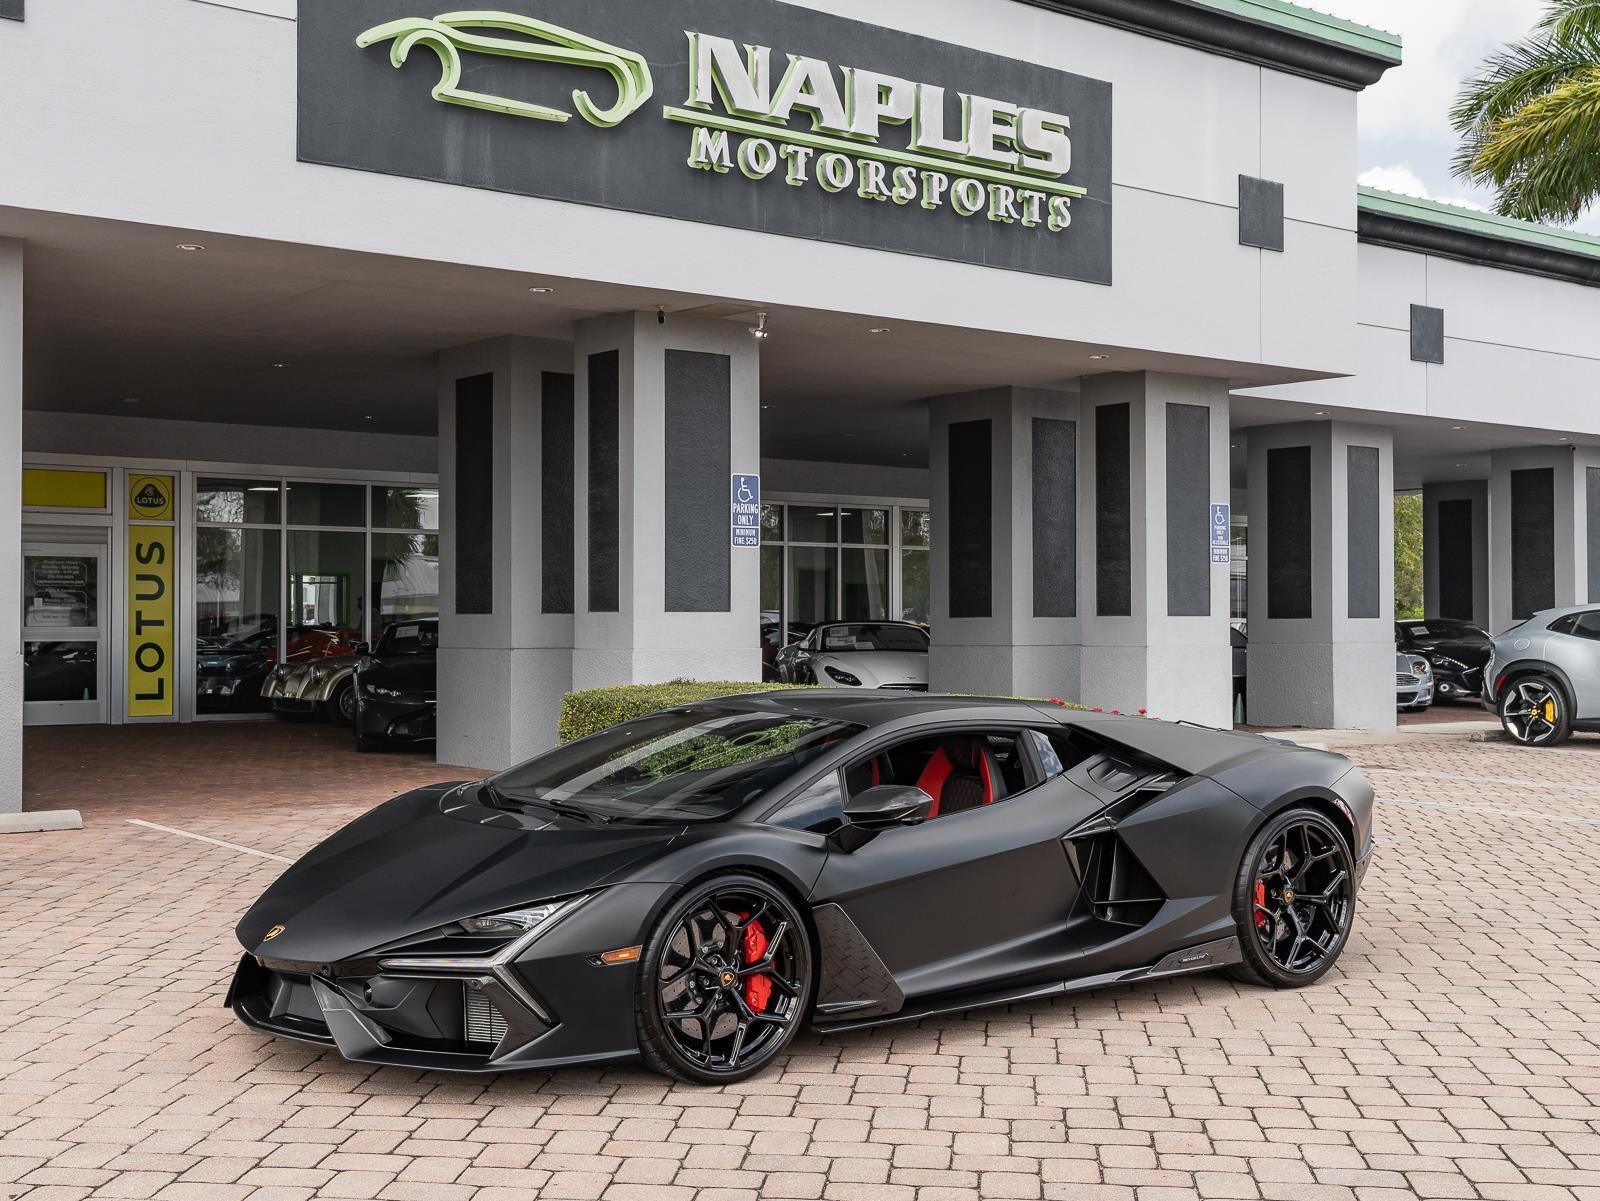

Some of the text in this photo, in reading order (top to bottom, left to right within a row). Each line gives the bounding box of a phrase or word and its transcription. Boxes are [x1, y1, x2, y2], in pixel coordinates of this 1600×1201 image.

[684, 31, 1072, 178] NAPLES
[687, 127, 1073, 231] MOTORSPORTS
[137, 496, 164, 505] LOTUS
[733, 503, 758, 514] PARKING
[737, 514, 753, 525] ONLY
[135, 541, 165, 701] LOTUS
